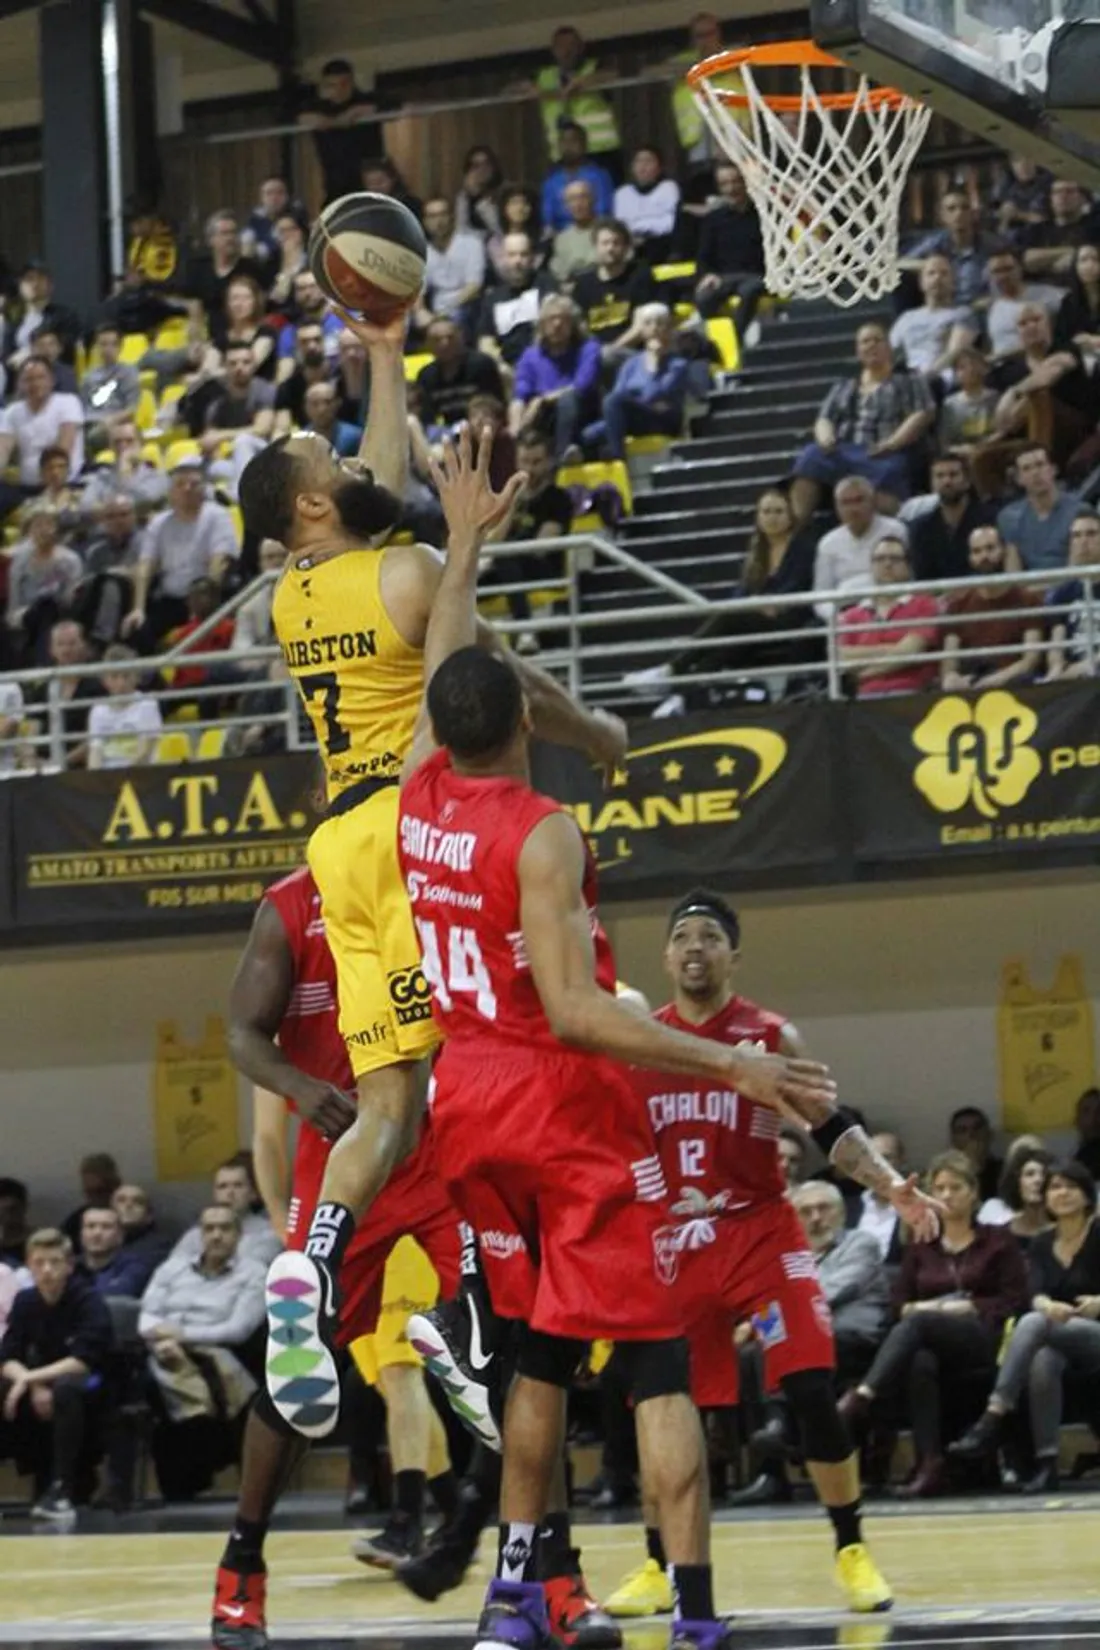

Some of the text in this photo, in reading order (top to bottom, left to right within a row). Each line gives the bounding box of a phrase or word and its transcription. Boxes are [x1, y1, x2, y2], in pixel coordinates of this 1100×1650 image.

[299, 671, 351, 756] 7
[102, 770, 306, 842] A.T.A.
[29, 859, 98, 881] AMATO
[103, 852, 229, 876] TRANSPORTS
[389, 968, 433, 1006] GO
[415, 915, 498, 1020] 44
[648, 1090, 738, 1133] CHALON
[679, 1139, 706, 1177] 12
